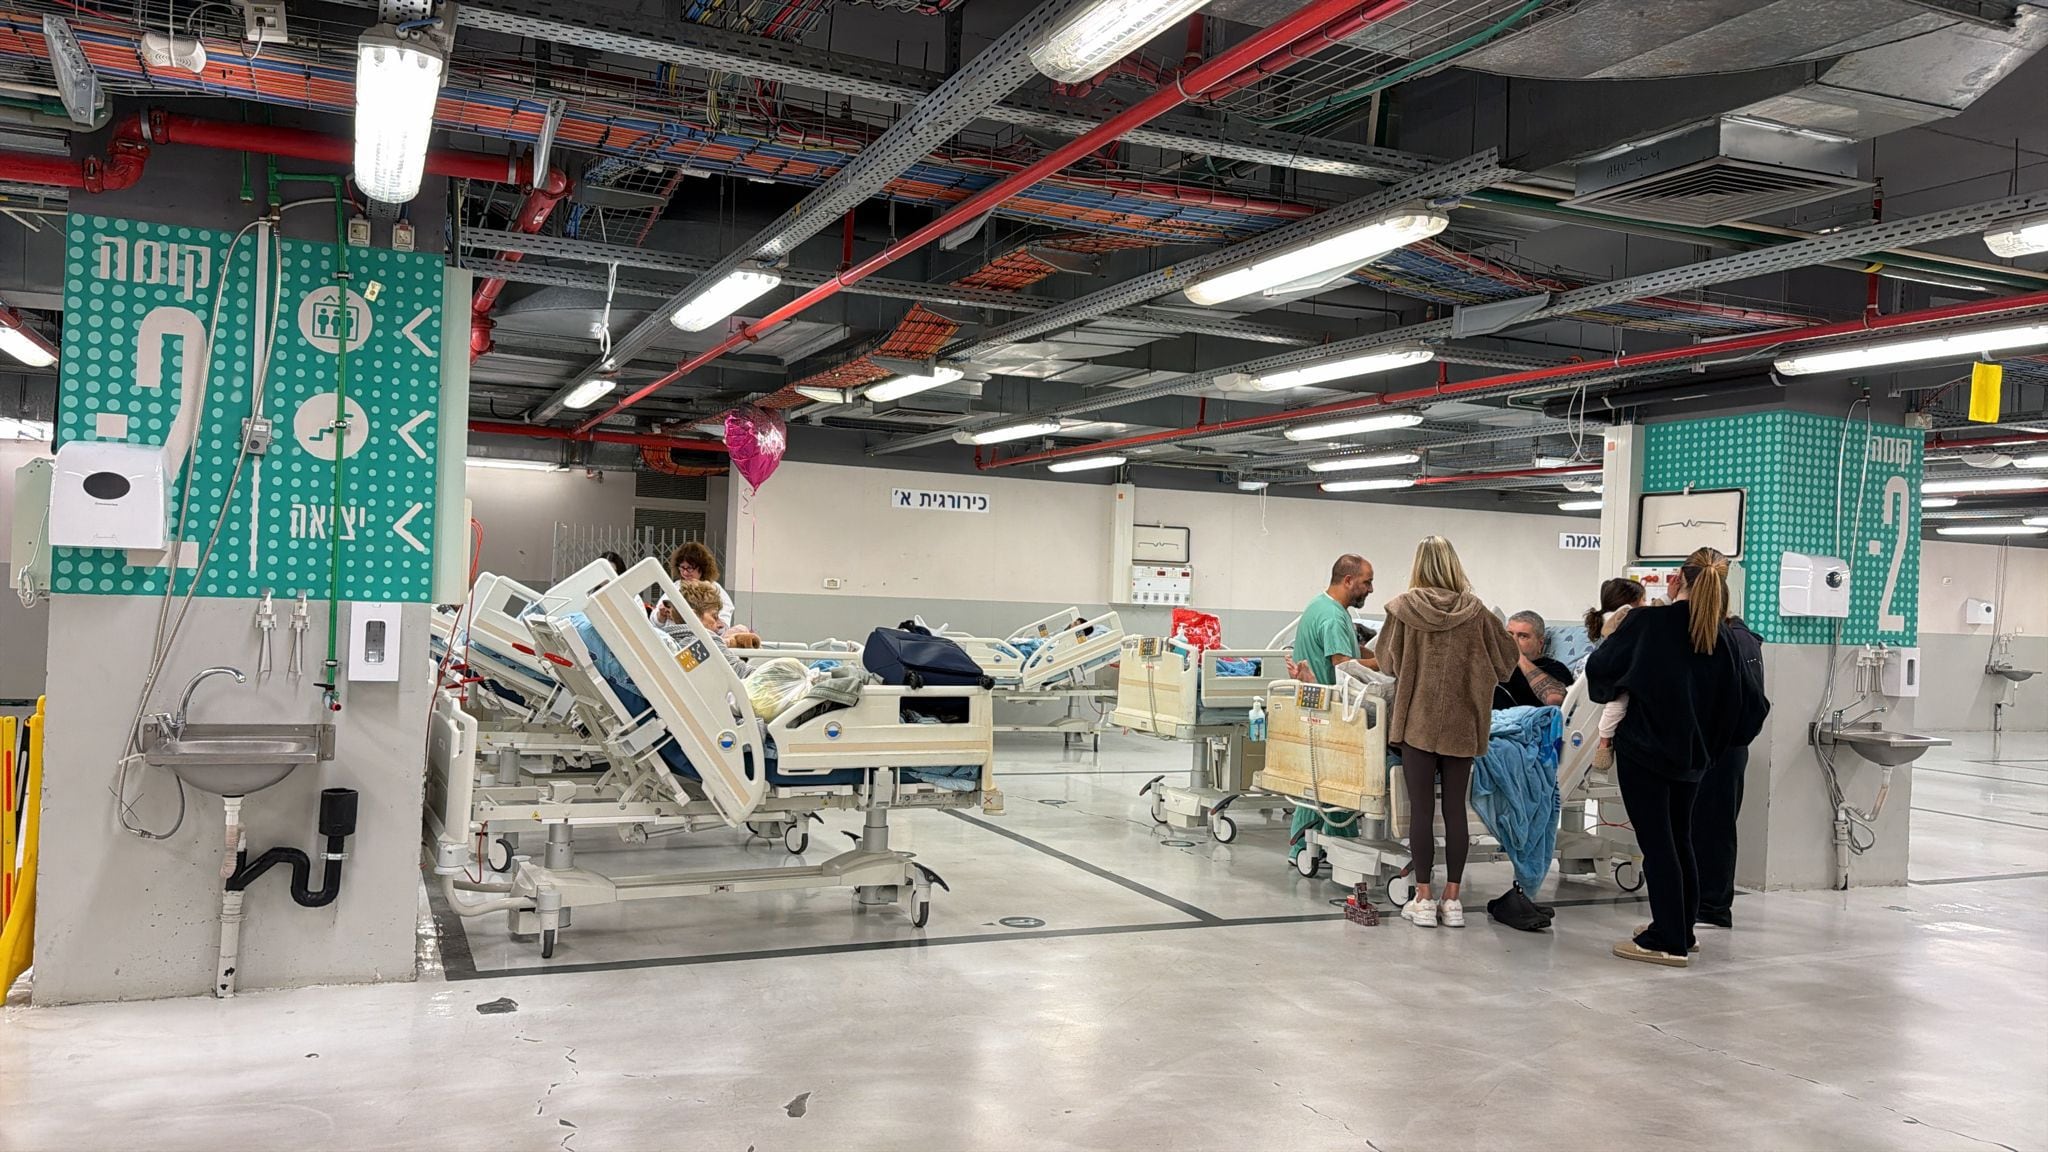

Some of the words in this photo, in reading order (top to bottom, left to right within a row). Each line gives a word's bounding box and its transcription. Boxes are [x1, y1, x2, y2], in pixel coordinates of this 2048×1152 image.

[100, 236, 211, 300] קומה
[1871, 436, 1912, 472] קומה
[920, 493, 987, 510] כירורגית
[290, 503, 366, 541] יציאה
